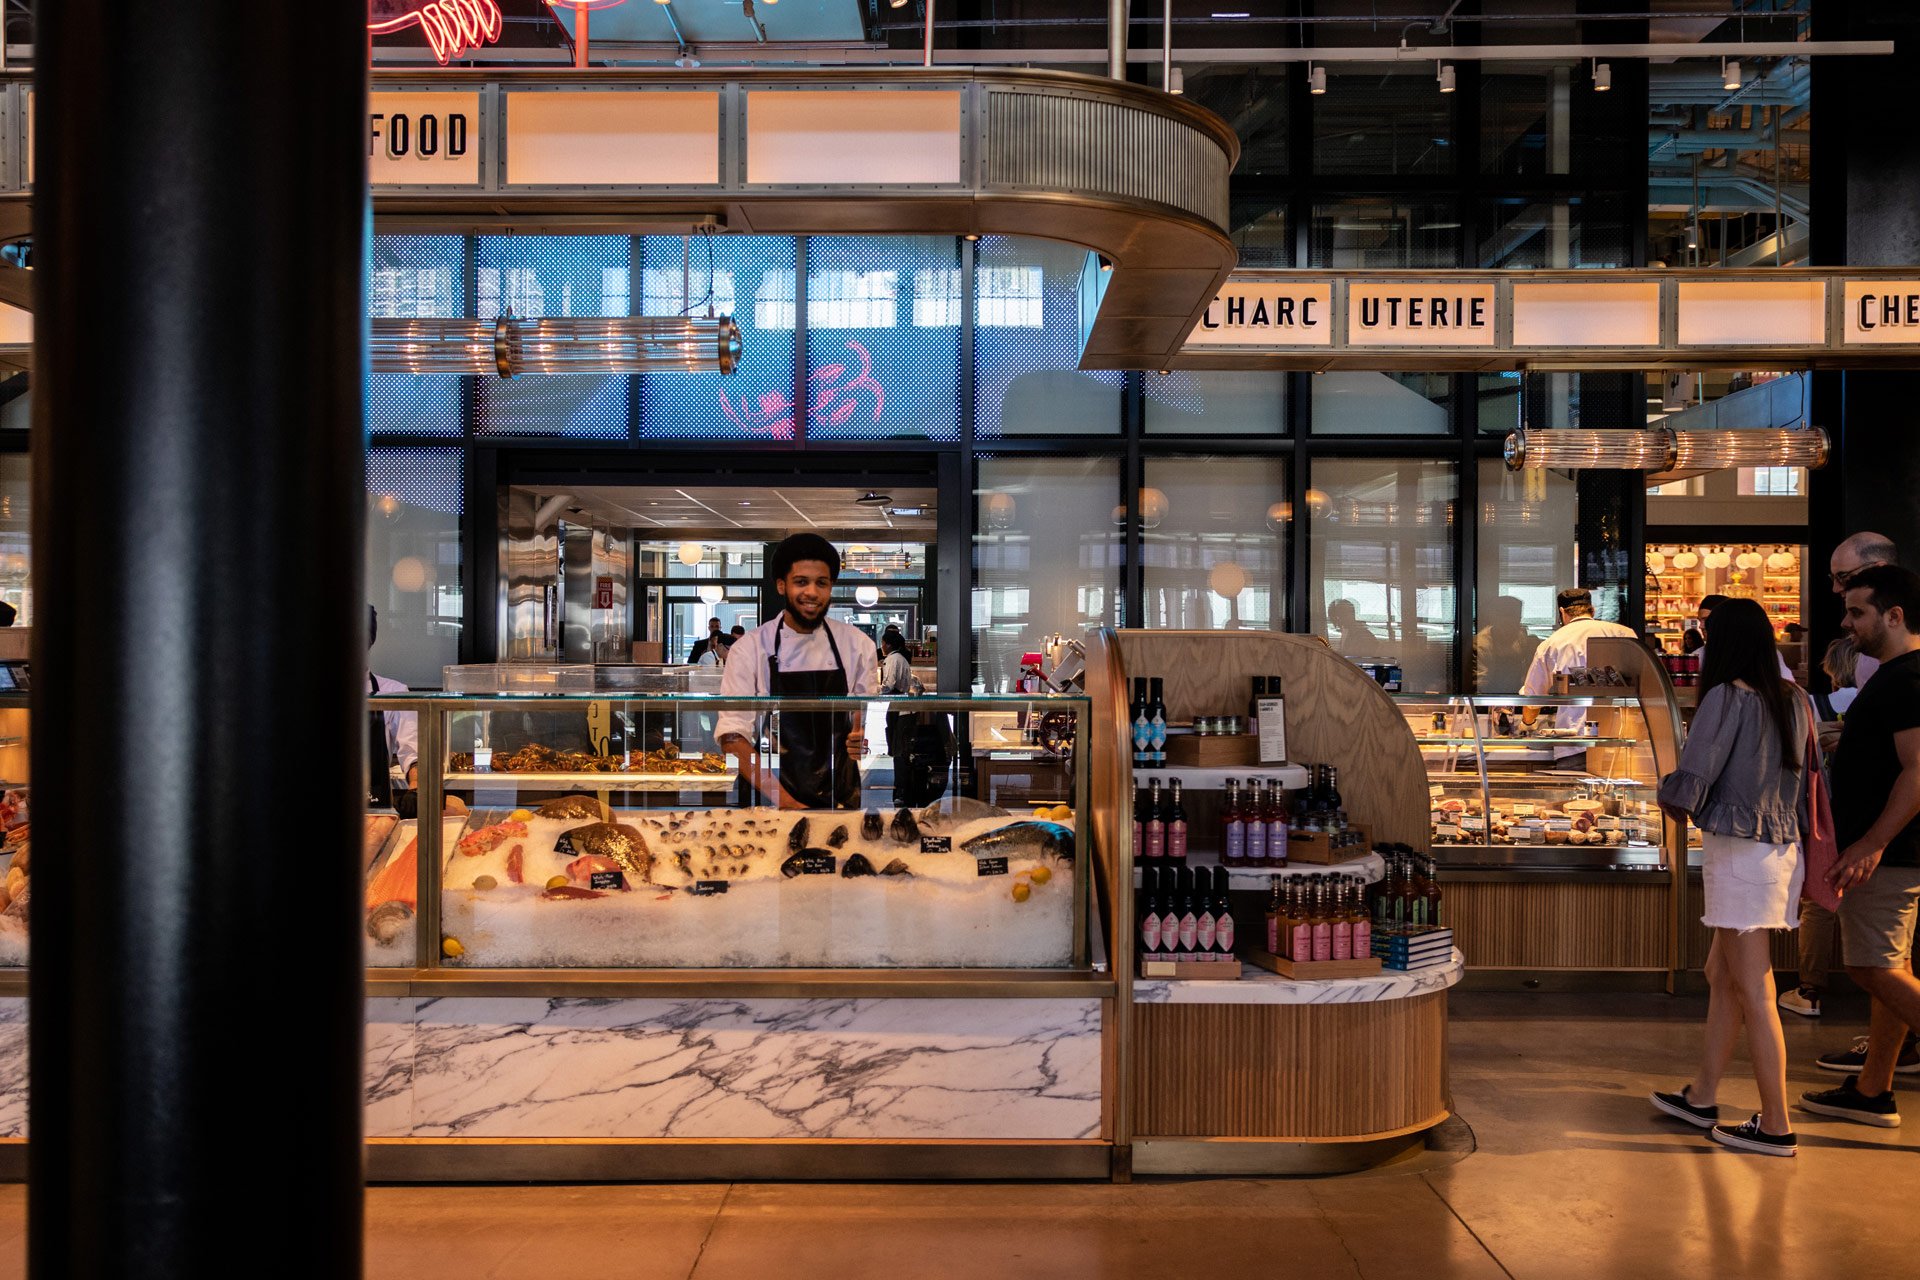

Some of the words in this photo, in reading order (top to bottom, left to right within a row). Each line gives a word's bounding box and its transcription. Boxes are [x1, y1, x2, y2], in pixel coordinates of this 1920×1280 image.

[368, 113, 467, 158] FOOD
[1203, 296, 1318, 329] CHARC
[1361, 297, 1485, 328] UTERIE
[1859, 294, 1919, 329] CHE
